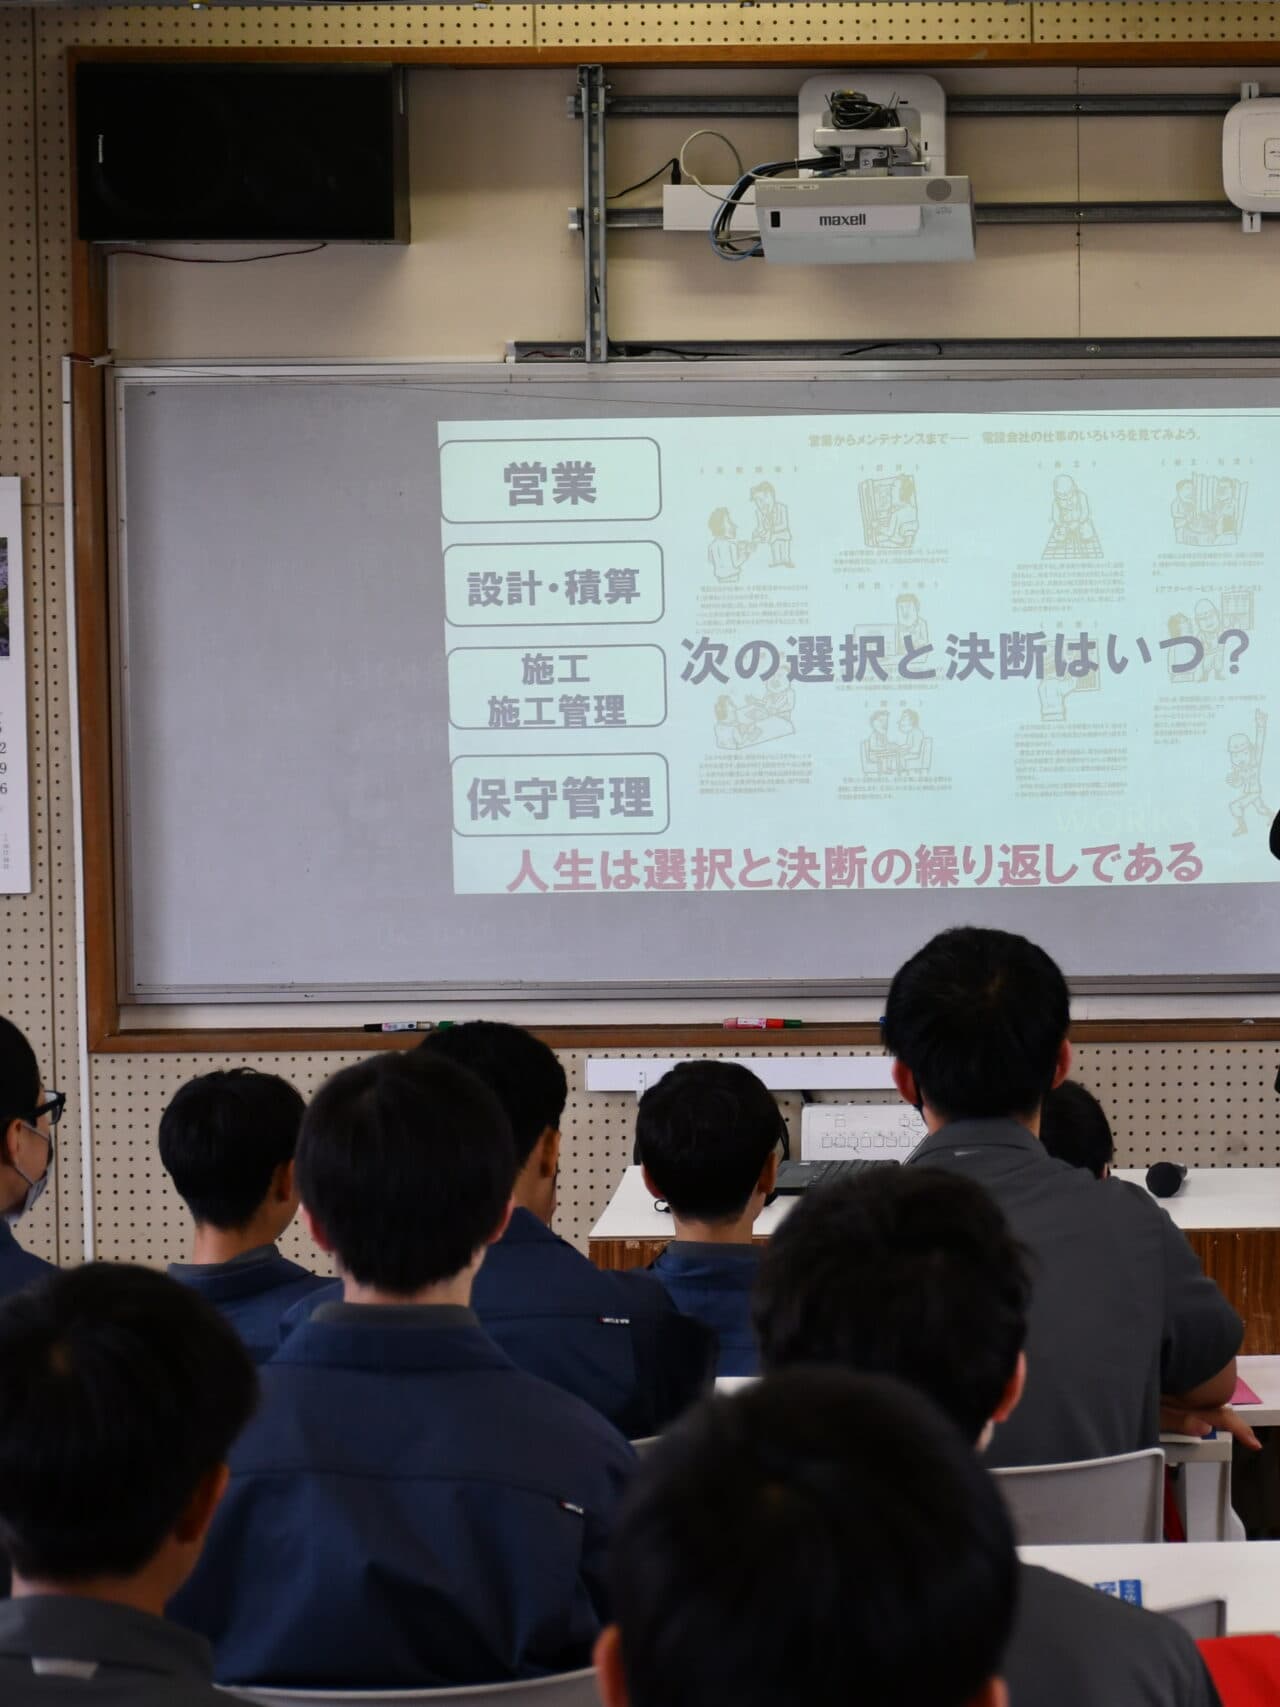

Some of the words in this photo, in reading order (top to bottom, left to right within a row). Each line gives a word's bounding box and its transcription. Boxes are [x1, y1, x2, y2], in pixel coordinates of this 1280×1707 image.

[819, 213, 866, 226] maxell
[504, 460, 597, 506] 営業
[467, 568, 641, 607] 設計・積算
[521, 653, 590, 685] 施工
[680, 629, 1250, 685] 次の選択と決断はいつ？
[487, 694, 627, 729] 施工管理
[466, 776, 654, 821] 保守管理
[506, 843, 1203, 893] 人生は選択と決断の繰り返しである
